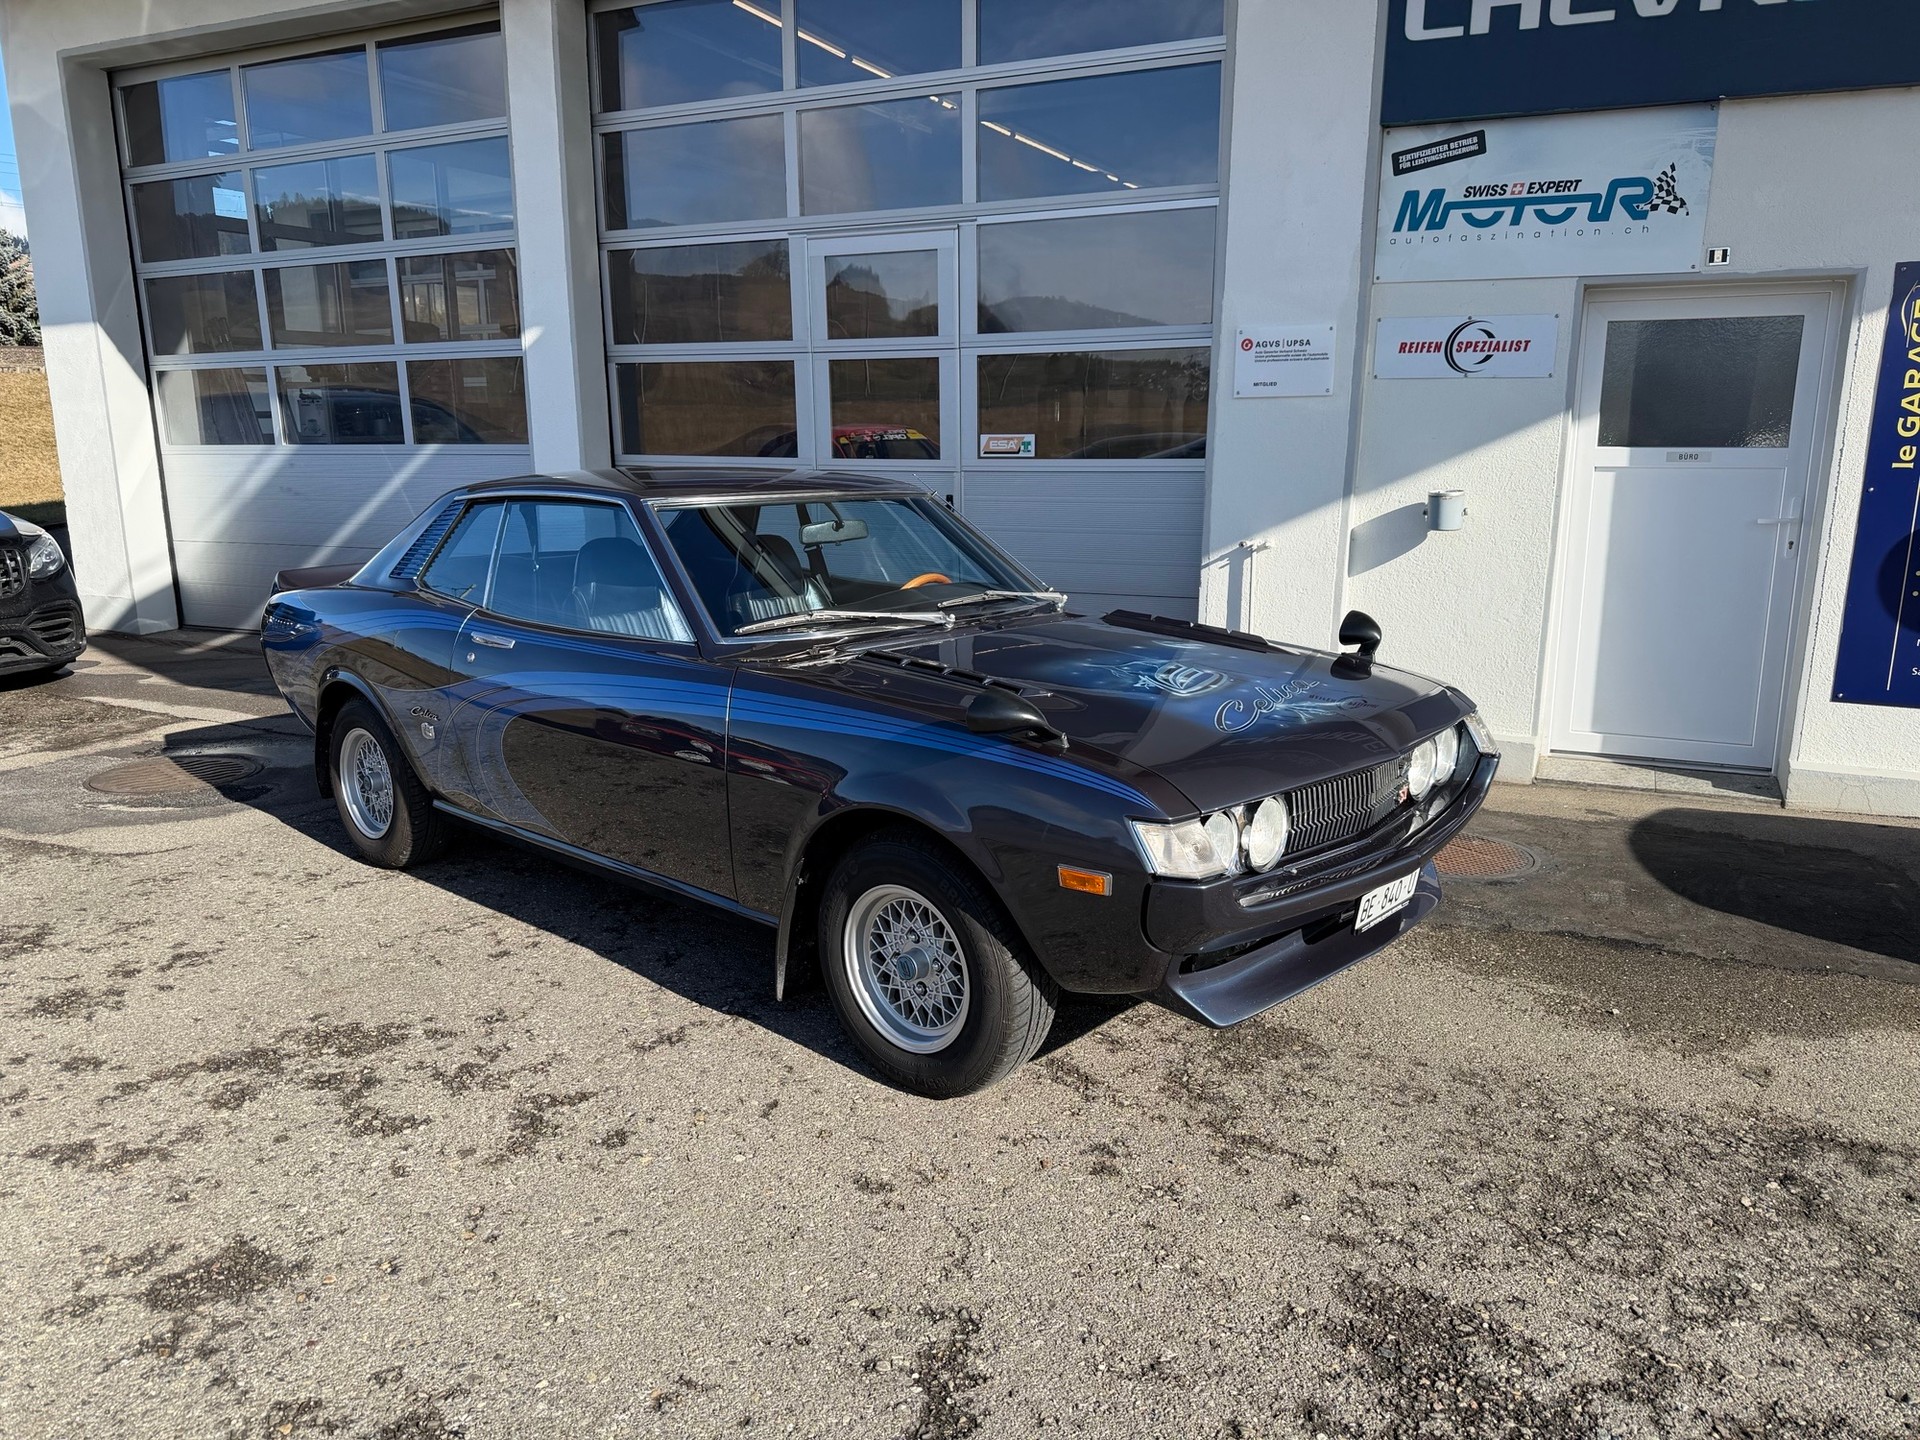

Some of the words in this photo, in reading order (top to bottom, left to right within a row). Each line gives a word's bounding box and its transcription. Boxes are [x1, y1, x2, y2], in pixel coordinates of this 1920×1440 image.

[1398, 144, 1449, 163] ZERTIFIZIERTER
[1449, 136, 1479, 150] BETRIEB
[1399, 160, 1411, 170] FÜR
[1411, 143, 1479, 167] LEISTUNGSSTEIGERUNG
[1463, 184, 1508, 198] SWISS
[1526, 179, 1582, 195] EXPERT
[1389, 225, 1650, 246] autofaszination.ch
[1255, 340, 1281, 349] AGVS
[1286, 339, 1311, 348] UPSA
[1398, 341, 1443, 354] REIFEN
[1455, 340, 1531, 353] SPEZIALIST
[1897, 299, 1920, 438] GARA
[990, 440, 1016, 449] ESA
[1678, 452, 1699, 461] BÜRO
